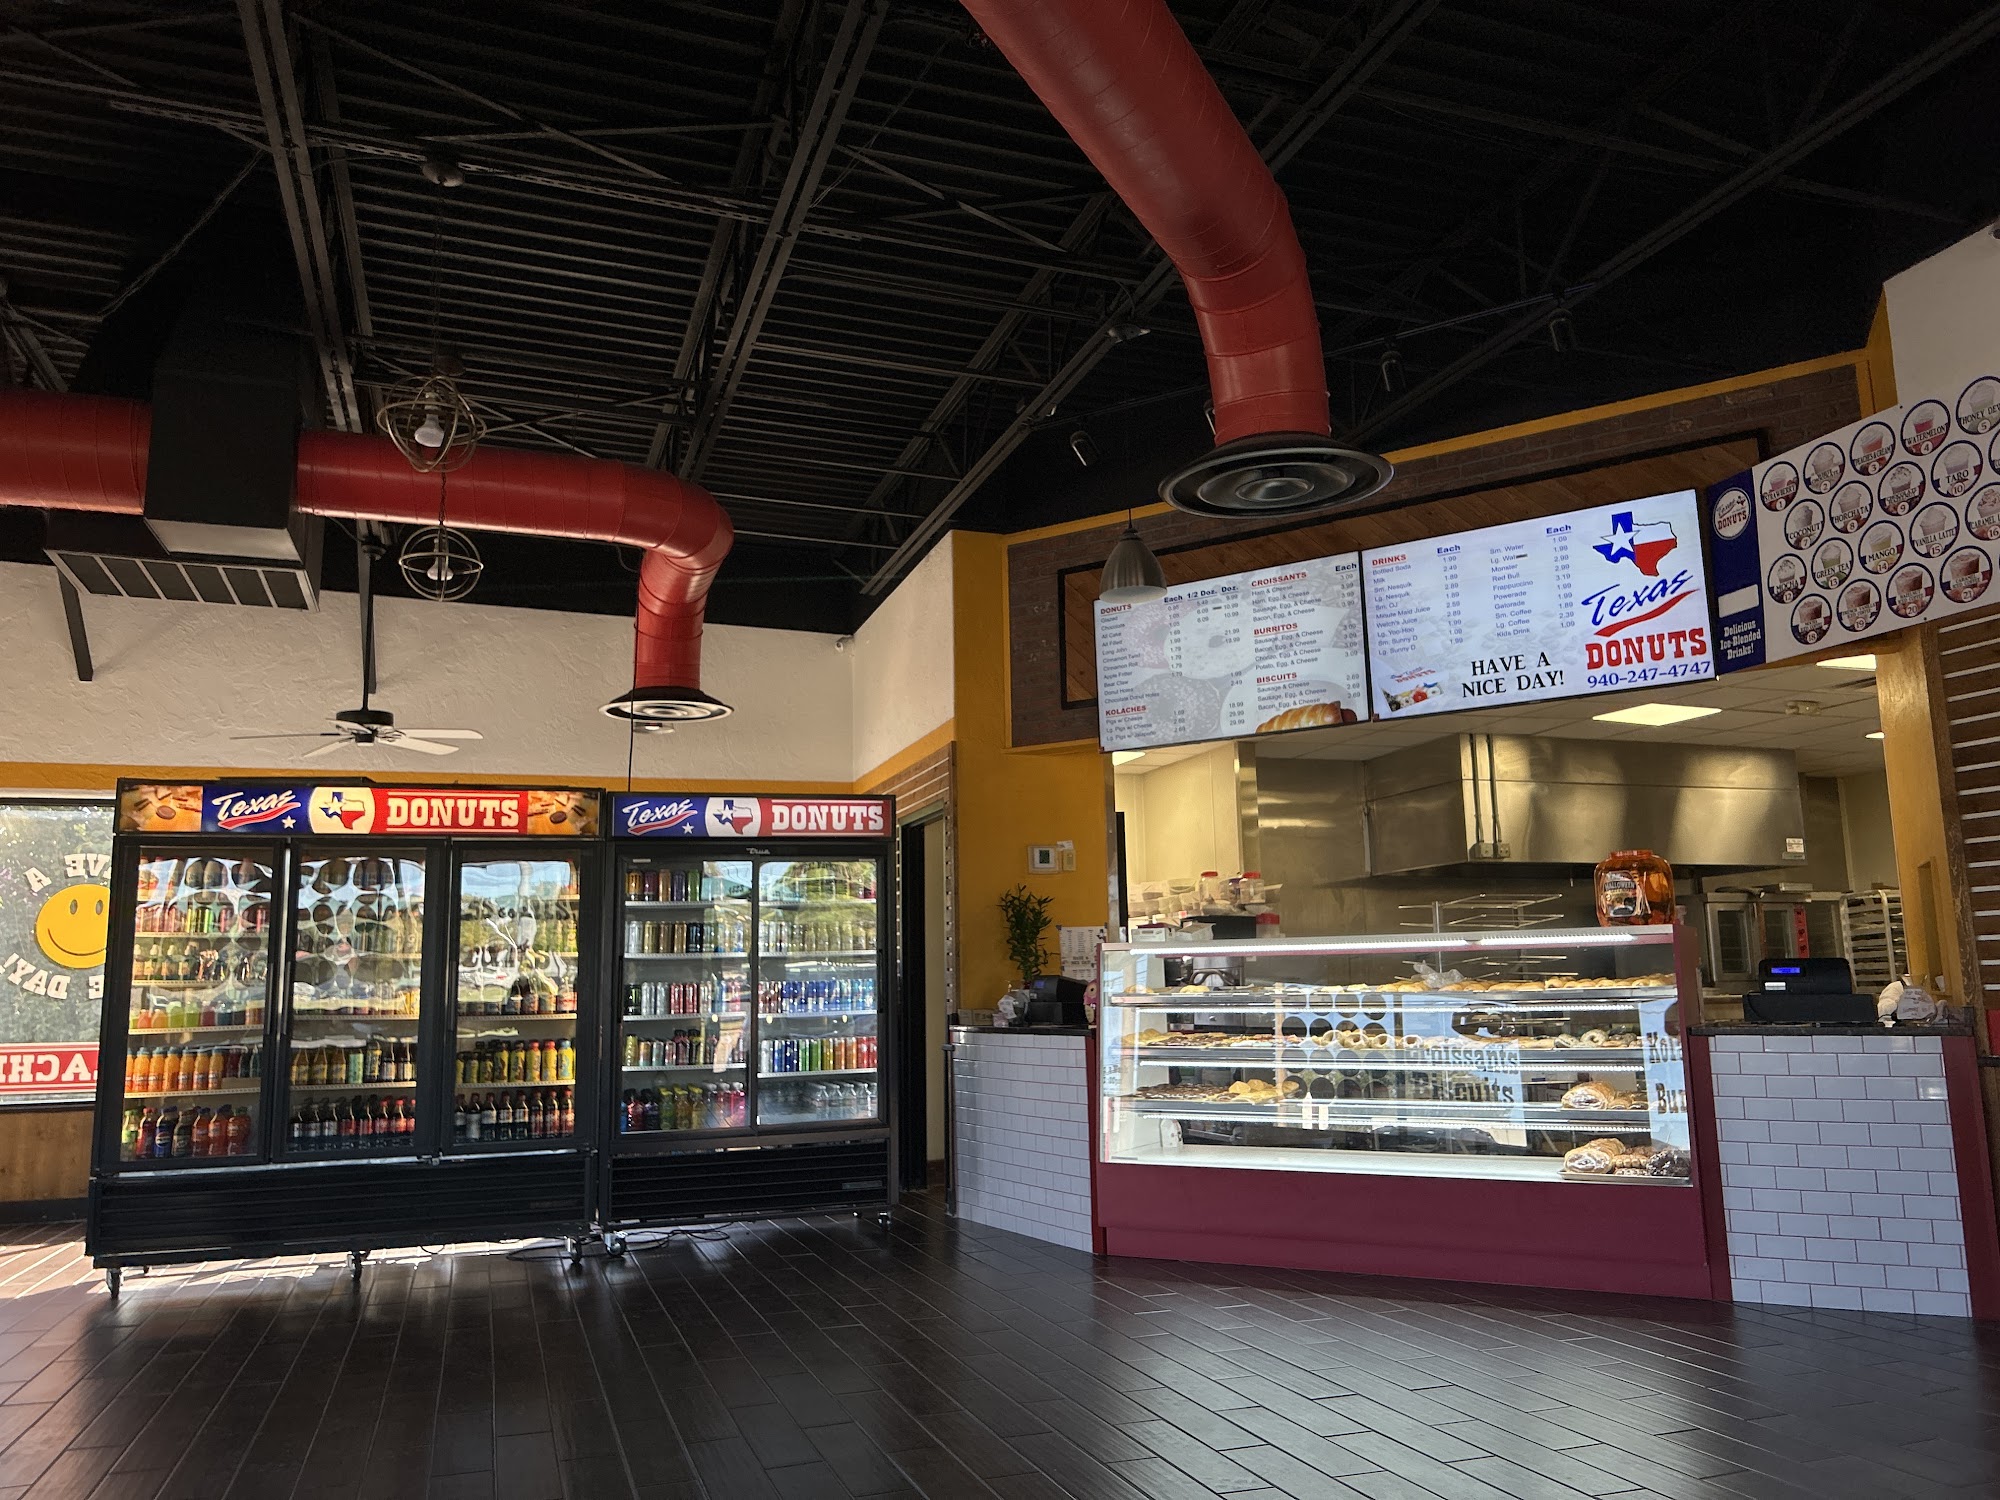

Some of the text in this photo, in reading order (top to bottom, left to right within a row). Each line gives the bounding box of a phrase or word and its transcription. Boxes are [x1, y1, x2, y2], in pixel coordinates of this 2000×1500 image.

[1962, 408, 1985, 424] HONEY
[1981, 422, 1987, 430] 5
[1908, 426, 1946, 444] WATERMELON
[1872, 462, 1876, 471] 3
[1946, 470, 1969, 484] TARO
[1953, 484, 1962, 494] 10
[1901, 504, 1906, 512] 9
[1835, 505, 1868, 523] HORCHATA
[1718, 510, 1747, 530] DONUTS
[1546, 524, 1571, 534] Each
[1850, 522, 1854, 530] 8
[1790, 523, 1820, 540] COCONUT
[1989, 529, 1998, 537] 16
[1916, 529, 1955, 546] VANILLA LATTE
[1437, 544, 1460, 553] Each
[1504, 543, 1524, 551] Water
[1932, 546, 1940, 554] 15
[1372, 554, 1406, 565] DRINKS
[1868, 548, 1895, 562] MANGO
[1335, 562, 1356, 571] Each
[1395, 563, 1410, 571] Soda
[1491, 563, 1517, 572] Monster
[1817, 563, 1850, 579] GREEN TEA
[1878, 562, 1887, 570] 14
[1251, 571, 1306, 587] CROISSANTS
[1271, 584, 1292, 592] Cheese
[1387, 581, 1411, 591] Nesquik
[1492, 579, 1533, 591] Frappuccino
[1776, 580, 1798, 593] MOCHA
[1164, 584, 1238, 603] Each 1/2 Doz. Doz.
[1385, 591, 1409, 600] Nesquik
[1493, 589, 1526, 600] Powerade
[1582, 570, 1694, 626] Texas
[1785, 593, 1792, 601] 12
[1963, 591, 1972, 599] 21
[1299, 597, 1321, 605] Cheese
[1494, 599, 1525, 609] Gatorade
[1100, 603, 1131, 614] DONUTS
[1293, 607, 1314, 615] Cheese
[1414, 605, 1430, 613] Juice
[1509, 608, 1531, 616] Coffee
[1908, 606, 1918, 614] 20
[1376, 620, 1399, 628] Welch's
[1507, 618, 1529, 626] Coffee
[1253, 622, 1297, 635] BURRITOS
[1512, 627, 1530, 635] Drink
[1724, 620, 1756, 636] Delicious
[1391, 636, 1410, 645] Sunny
[1720, 629, 1761, 650] Ice-Blended
[1390, 645, 1409, 654] Sunny
[1586, 628, 1707, 670] DONUTS
[1727, 644, 1754, 660] Drinks!
[1471, 651, 1551, 676] HAVE A
[1256, 672, 1297, 683] BISCUITS
[1587, 661, 1710, 689] 940-247-4747
[1257, 685, 1280, 693] Sausage
[1461, 670, 1565, 698] NICE DAY!
[1105, 704, 1146, 715] KOLACHES
[212, 790, 296, 821] Texas
[387, 797, 519, 828] DONUTS
[622, 798, 692, 827] Texas
[772, 804, 884, 830] DONUTS
